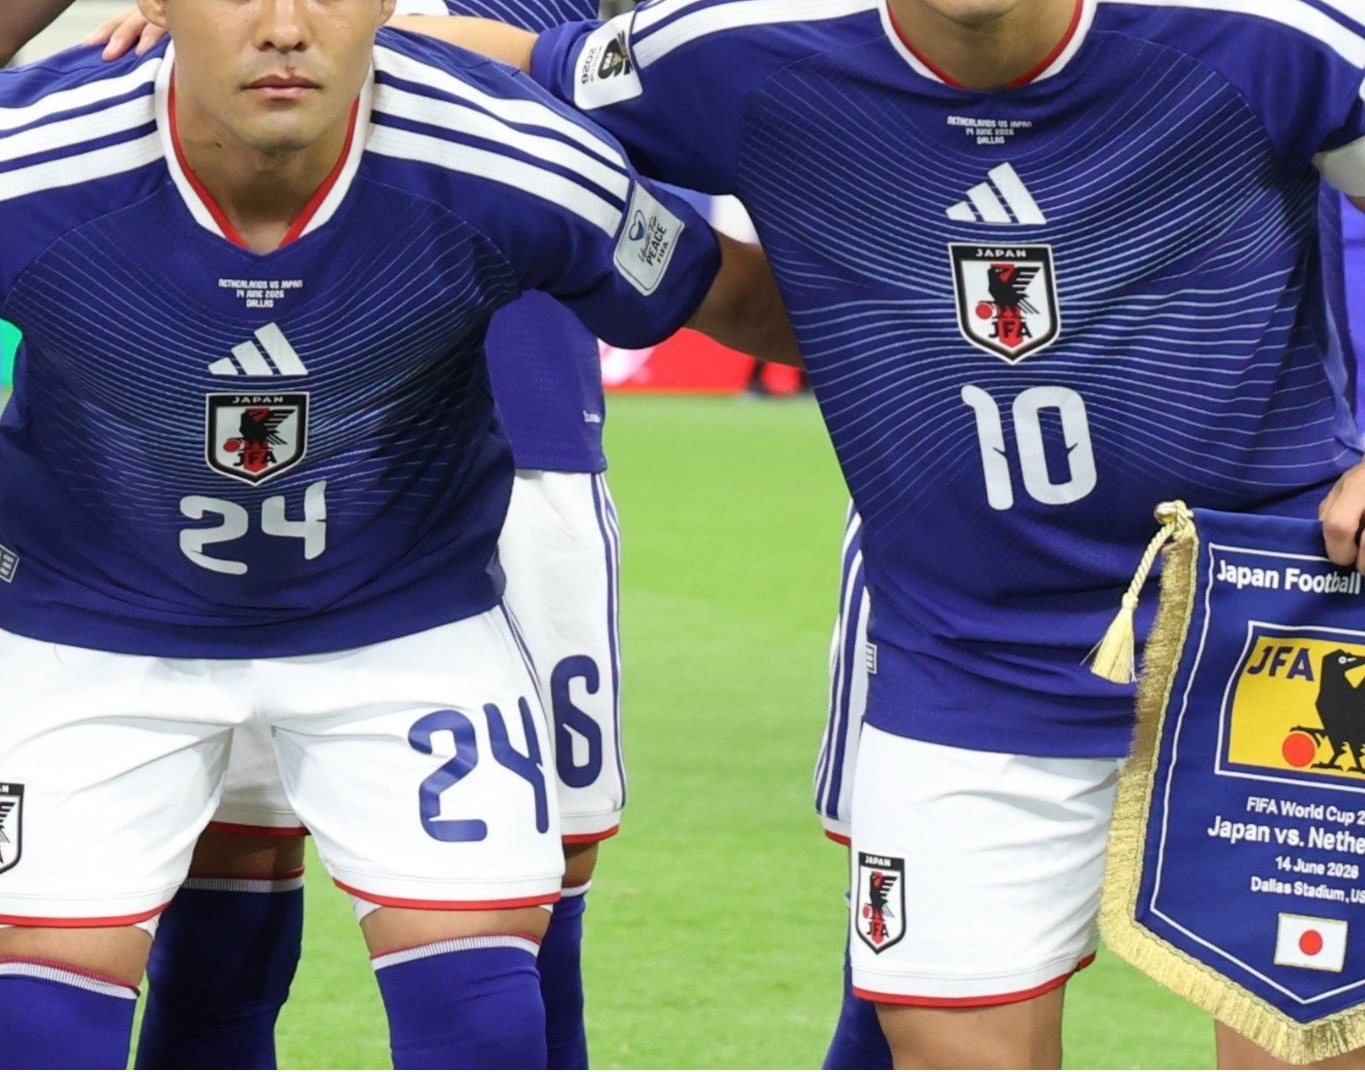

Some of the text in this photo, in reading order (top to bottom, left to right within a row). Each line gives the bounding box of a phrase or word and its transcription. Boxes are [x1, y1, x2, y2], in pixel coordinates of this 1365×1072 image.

[976, 136, 1005, 145] DALLAS
[646, 222, 667, 267] PEACE
[657, 241, 669, 264] FIFA
[975, 248, 1027, 258] JAPAN
[246, 299, 274, 308] DALLAS
[988, 320, 1033, 339] JFA
[232, 451, 277, 466] JFA
[961, 385, 1097, 510] 10
[180, 480, 327, 575] 24
[1217, 560, 1361, 595] Japan Football
[1247, 646, 1314, 681] JFA
[551, 655, 602, 788] 6
[408, 696, 549, 842] 24
[1246, 796, 1278, 815] FIFA
[1280, 800, 1324, 820] World
[1326, 806, 1355, 826] Cup
[1207, 815, 1270, 844] Japan
[1274, 828, 1305, 846] vs.
[865, 854, 891, 867] JAPAN
[1275, 856, 1359, 879] 14 June 2026
[1251, 876, 1292, 894] Dallas
[866, 922, 889, 938] JFA
